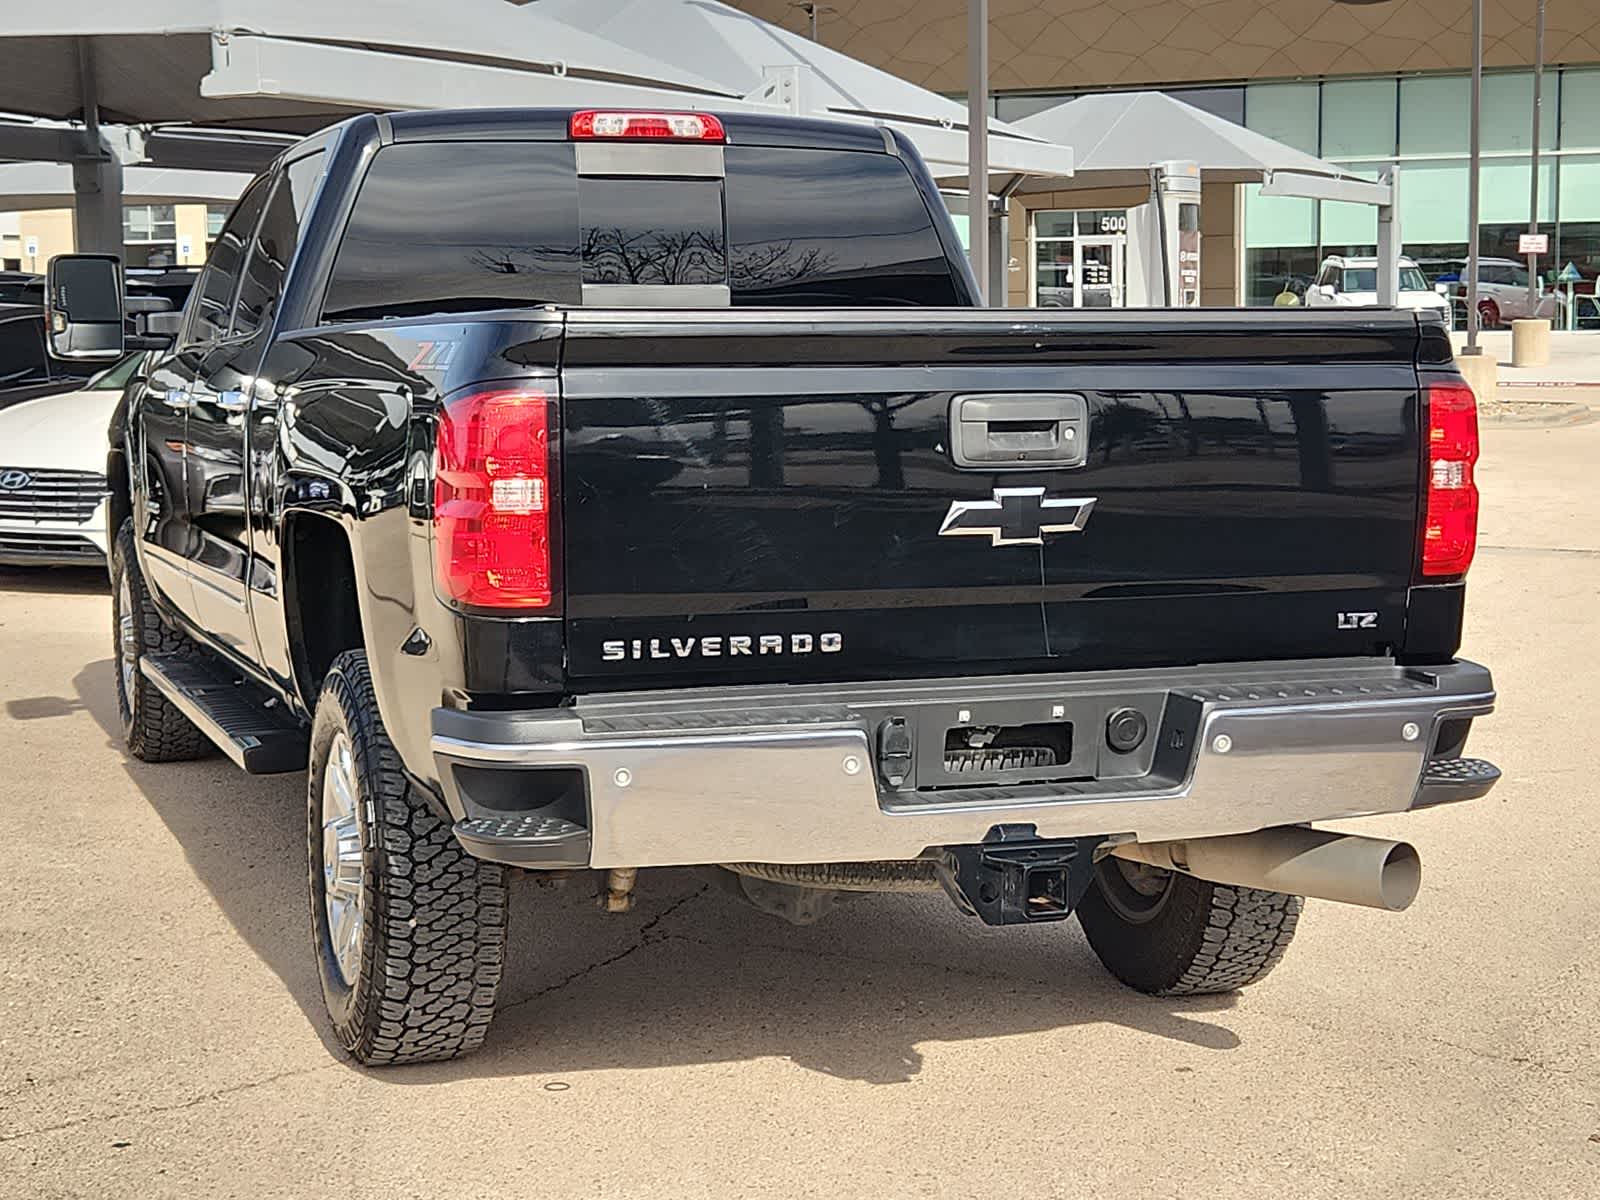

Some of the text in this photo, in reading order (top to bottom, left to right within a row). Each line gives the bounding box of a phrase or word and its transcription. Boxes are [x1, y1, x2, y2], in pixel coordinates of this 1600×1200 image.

[1101, 216, 1126, 231] 500
[1337, 612, 1378, 629] LTZ
[602, 632, 843, 661] SILVERADO
